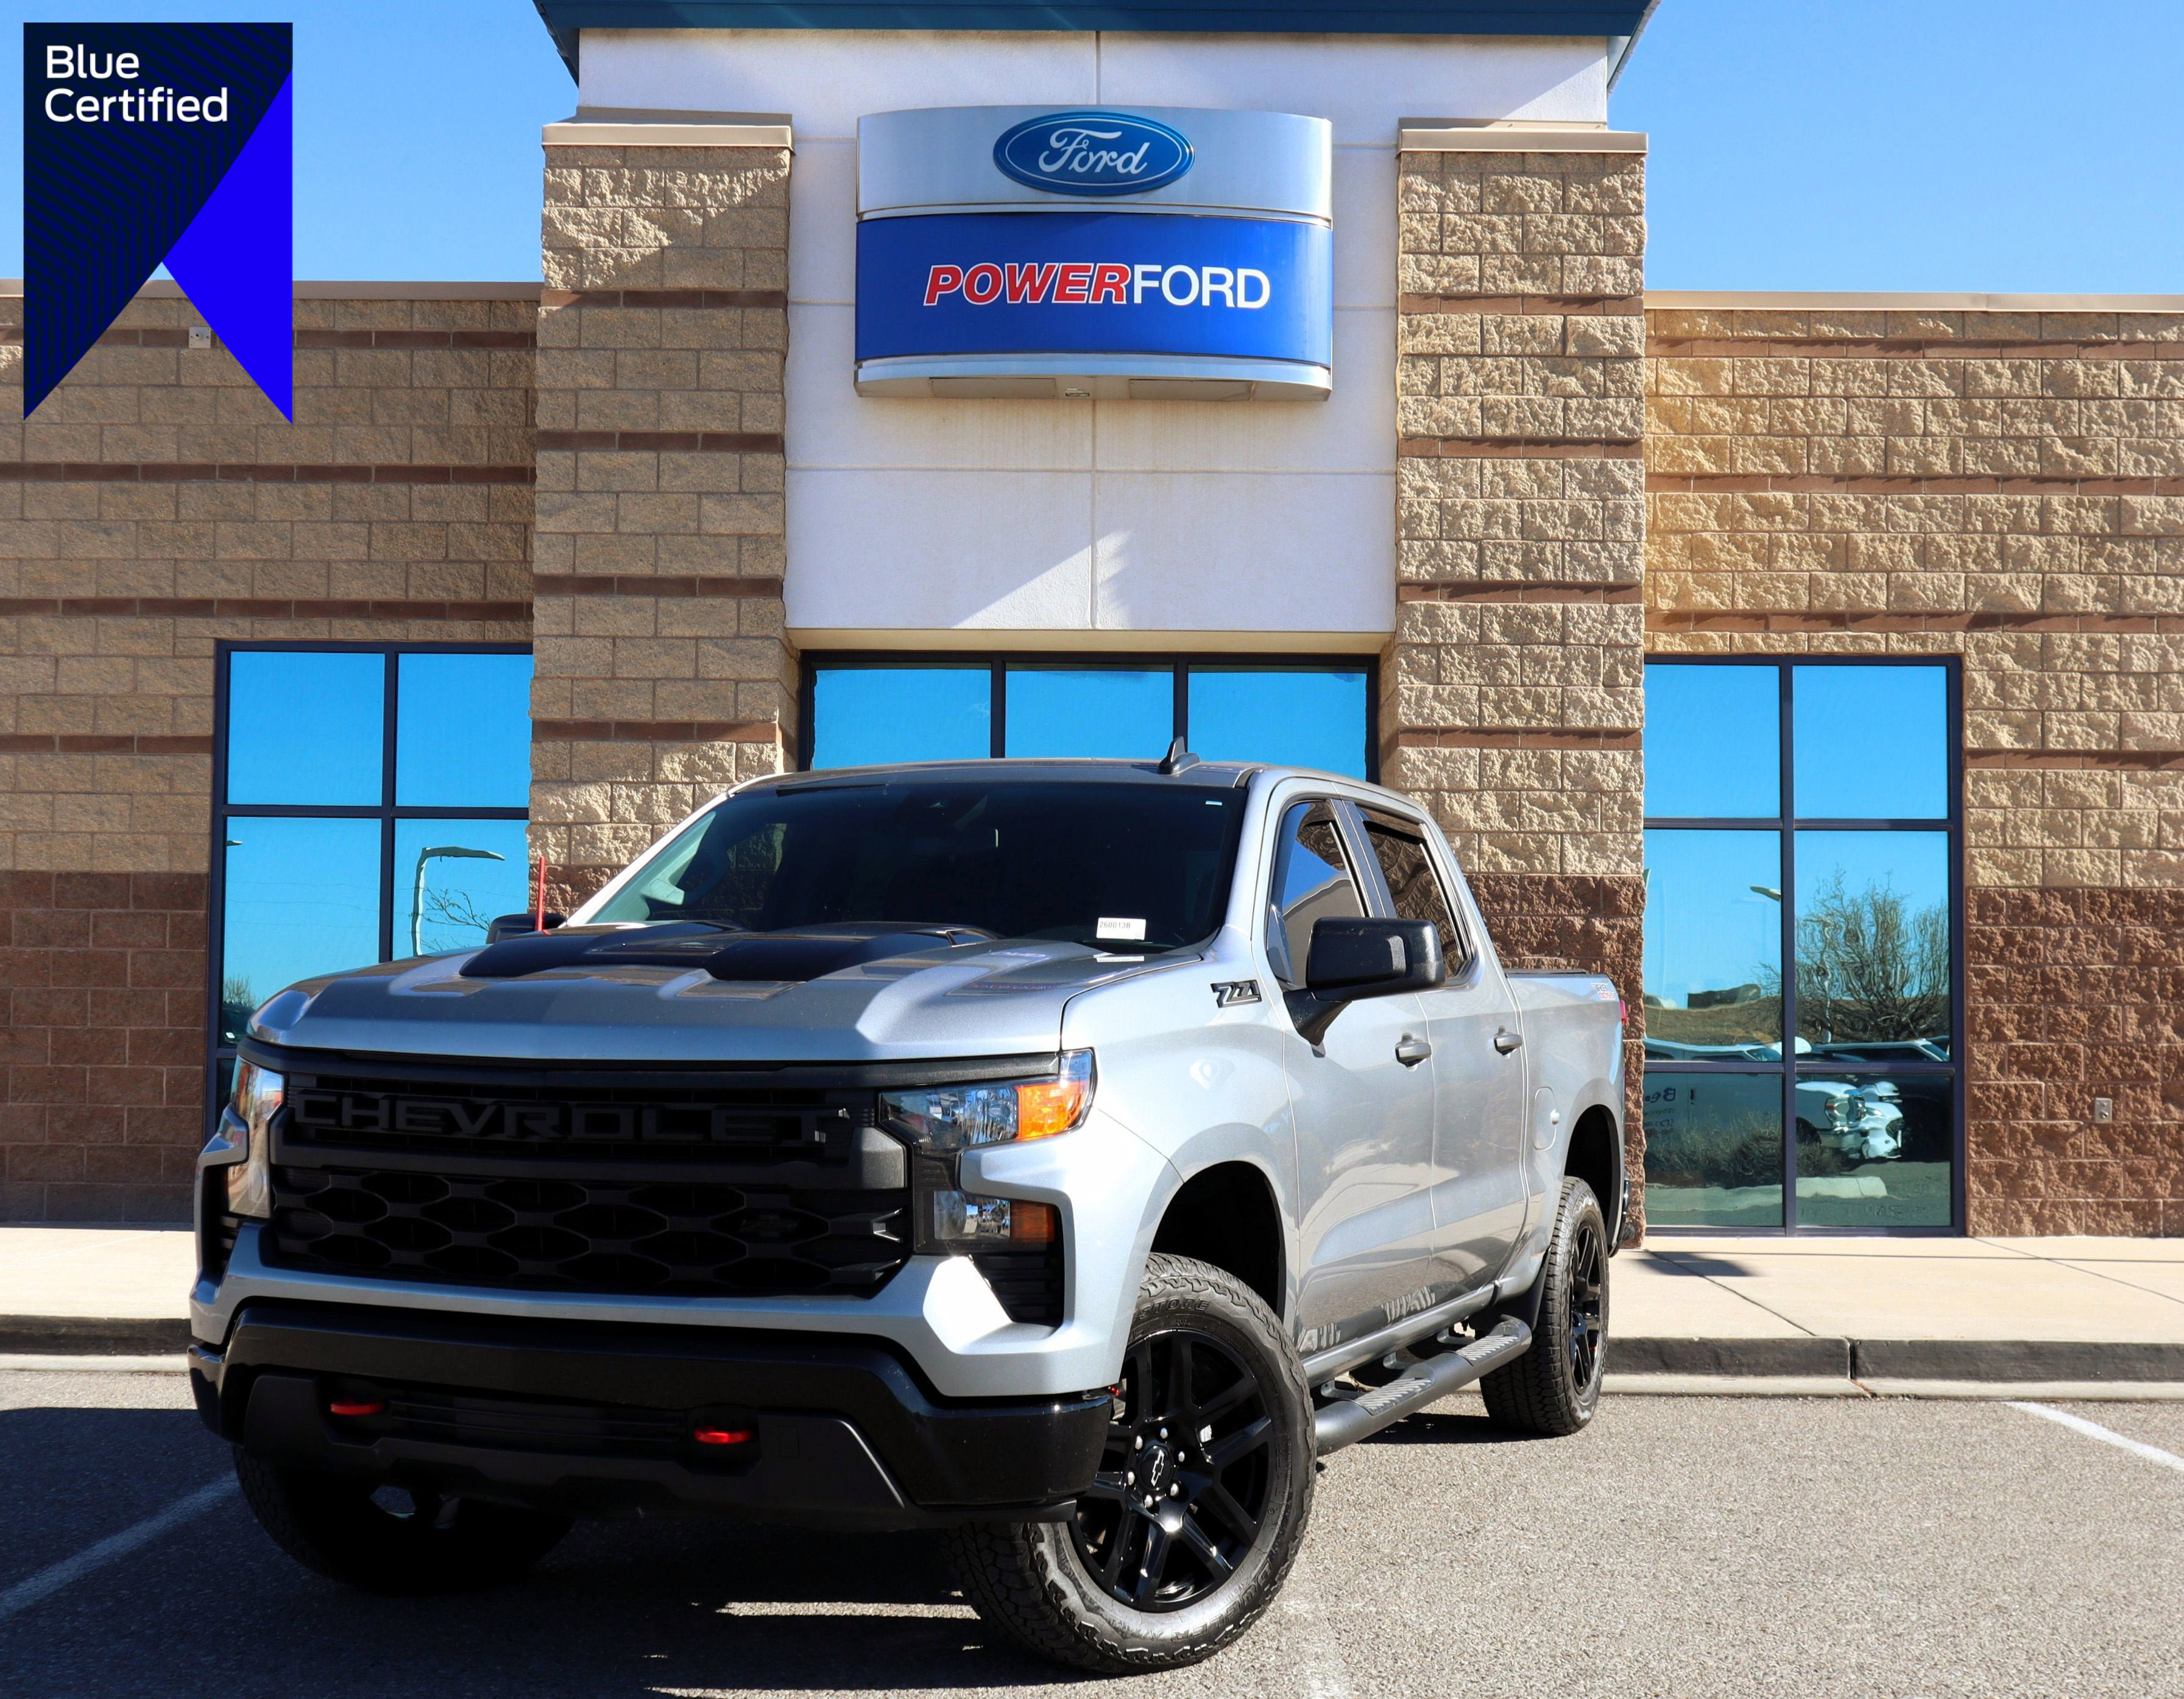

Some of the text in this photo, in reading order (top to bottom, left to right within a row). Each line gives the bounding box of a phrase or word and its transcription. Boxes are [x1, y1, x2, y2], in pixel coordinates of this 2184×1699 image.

[1039, 127, 1150, 175] Ford
[1210, 980, 1262, 1008] Z71
[294, 1088, 849, 1146] CHEVROLET
